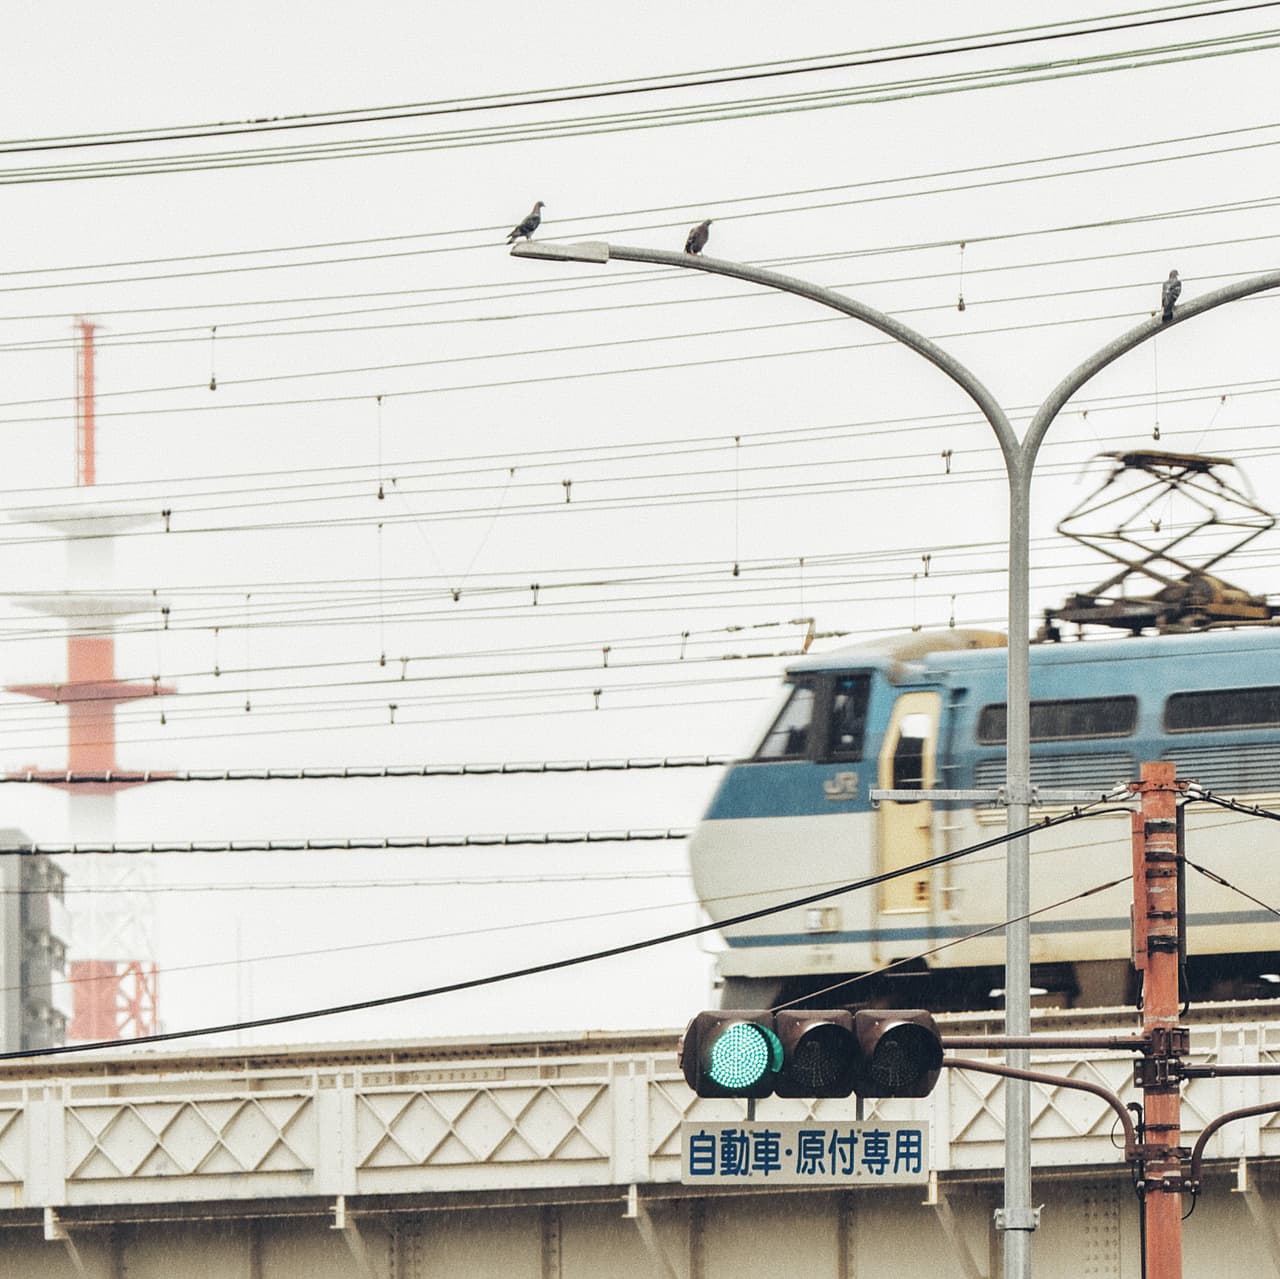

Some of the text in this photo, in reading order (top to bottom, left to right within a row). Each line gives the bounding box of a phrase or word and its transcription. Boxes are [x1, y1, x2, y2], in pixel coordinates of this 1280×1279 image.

[823, 771, 858, 796] JR
[689, 1128, 922, 1176] 自動車・原付専用
